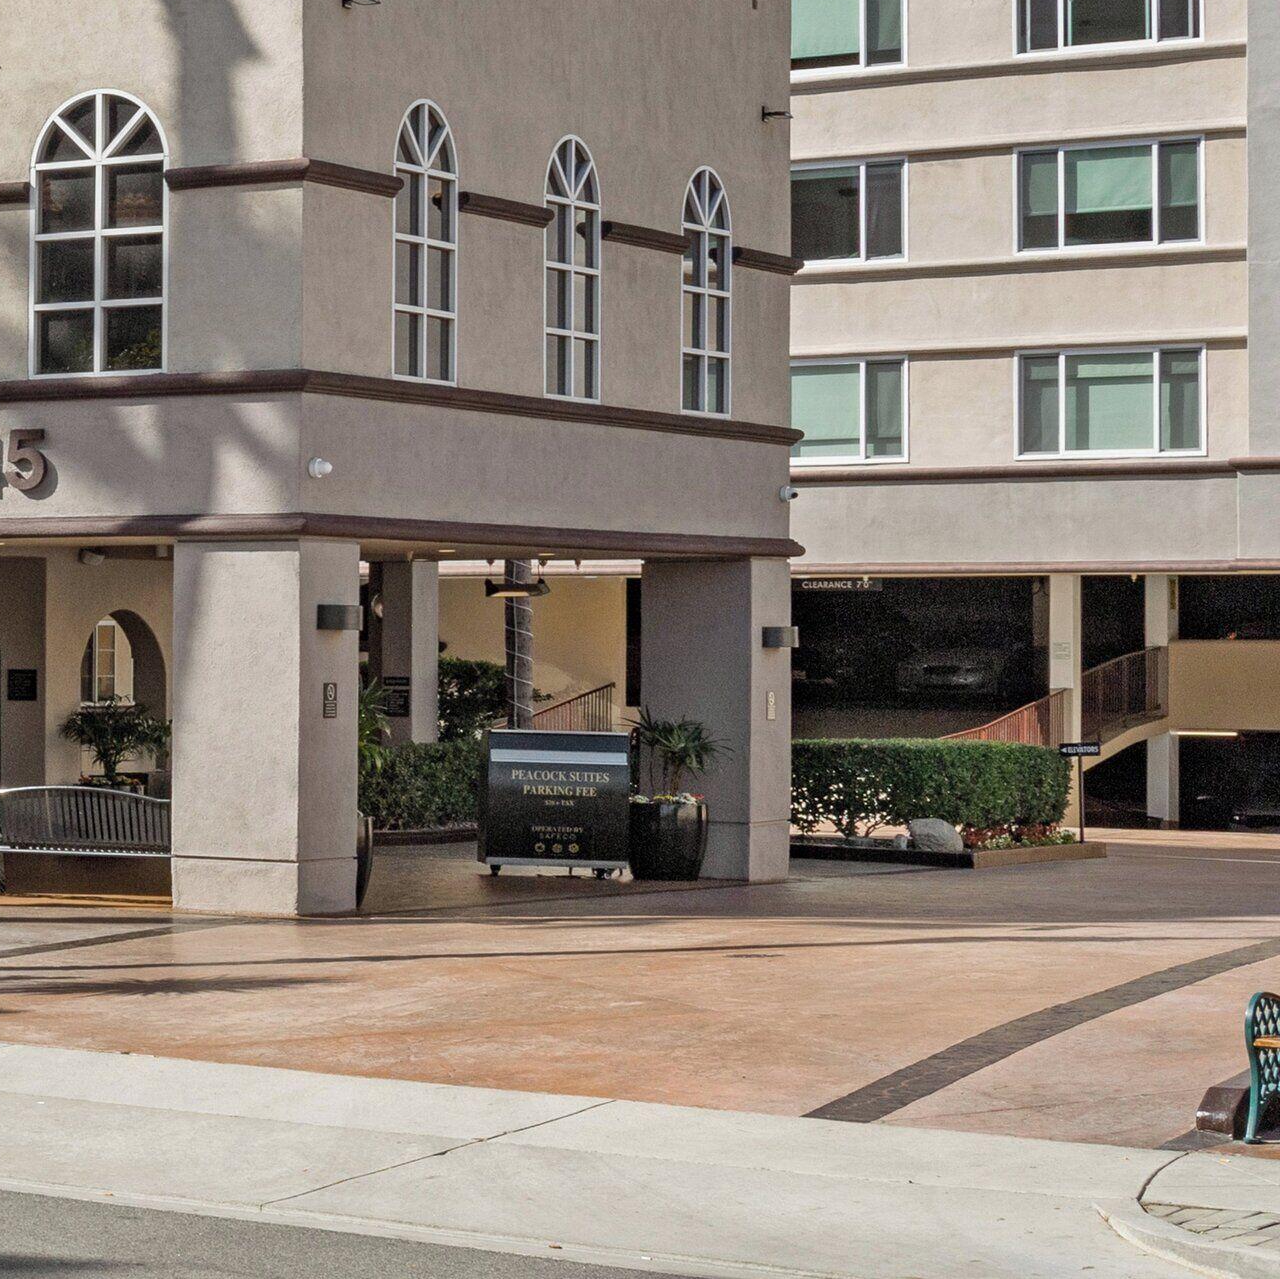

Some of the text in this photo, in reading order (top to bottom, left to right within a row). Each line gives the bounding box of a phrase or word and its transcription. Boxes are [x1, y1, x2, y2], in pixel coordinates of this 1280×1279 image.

[801, 580, 853, 589] CLEARANCE
[1067, 745, 1099, 754] ELEVATORS
[511, 769, 610, 783] PEACOCK SUITES
[522, 784, 598, 797] PARKING FEE
